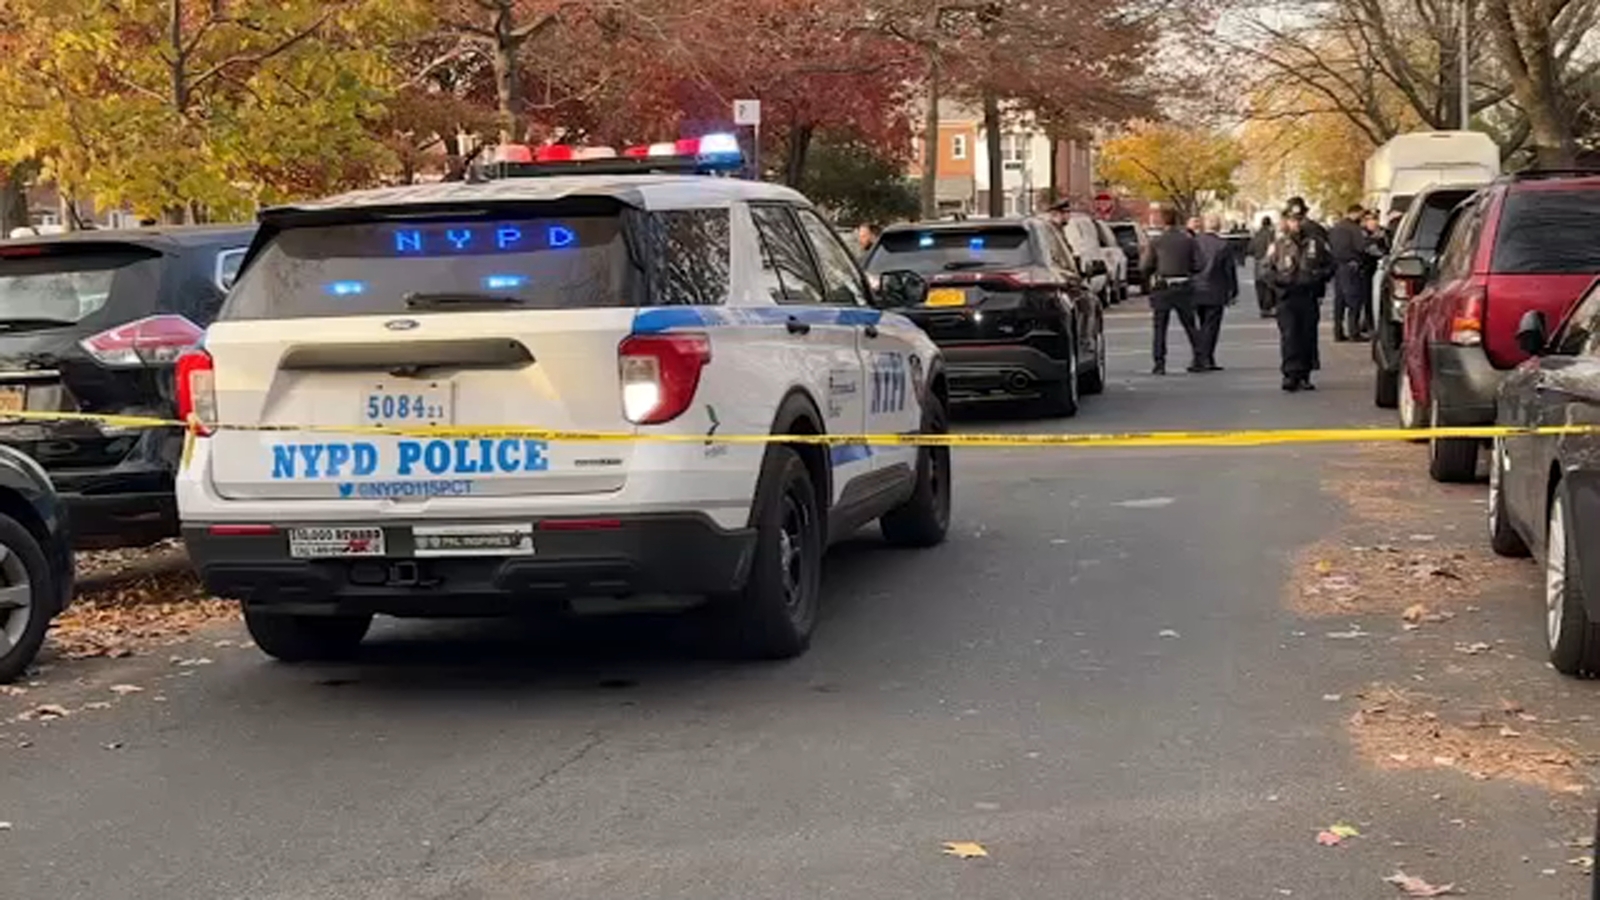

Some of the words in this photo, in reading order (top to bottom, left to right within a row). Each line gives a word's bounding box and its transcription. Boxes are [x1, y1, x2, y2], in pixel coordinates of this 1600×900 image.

[367, 394, 425, 419] 5084
[272, 442, 378, 478] NYPD
[397, 438, 549, 475] POLICE
